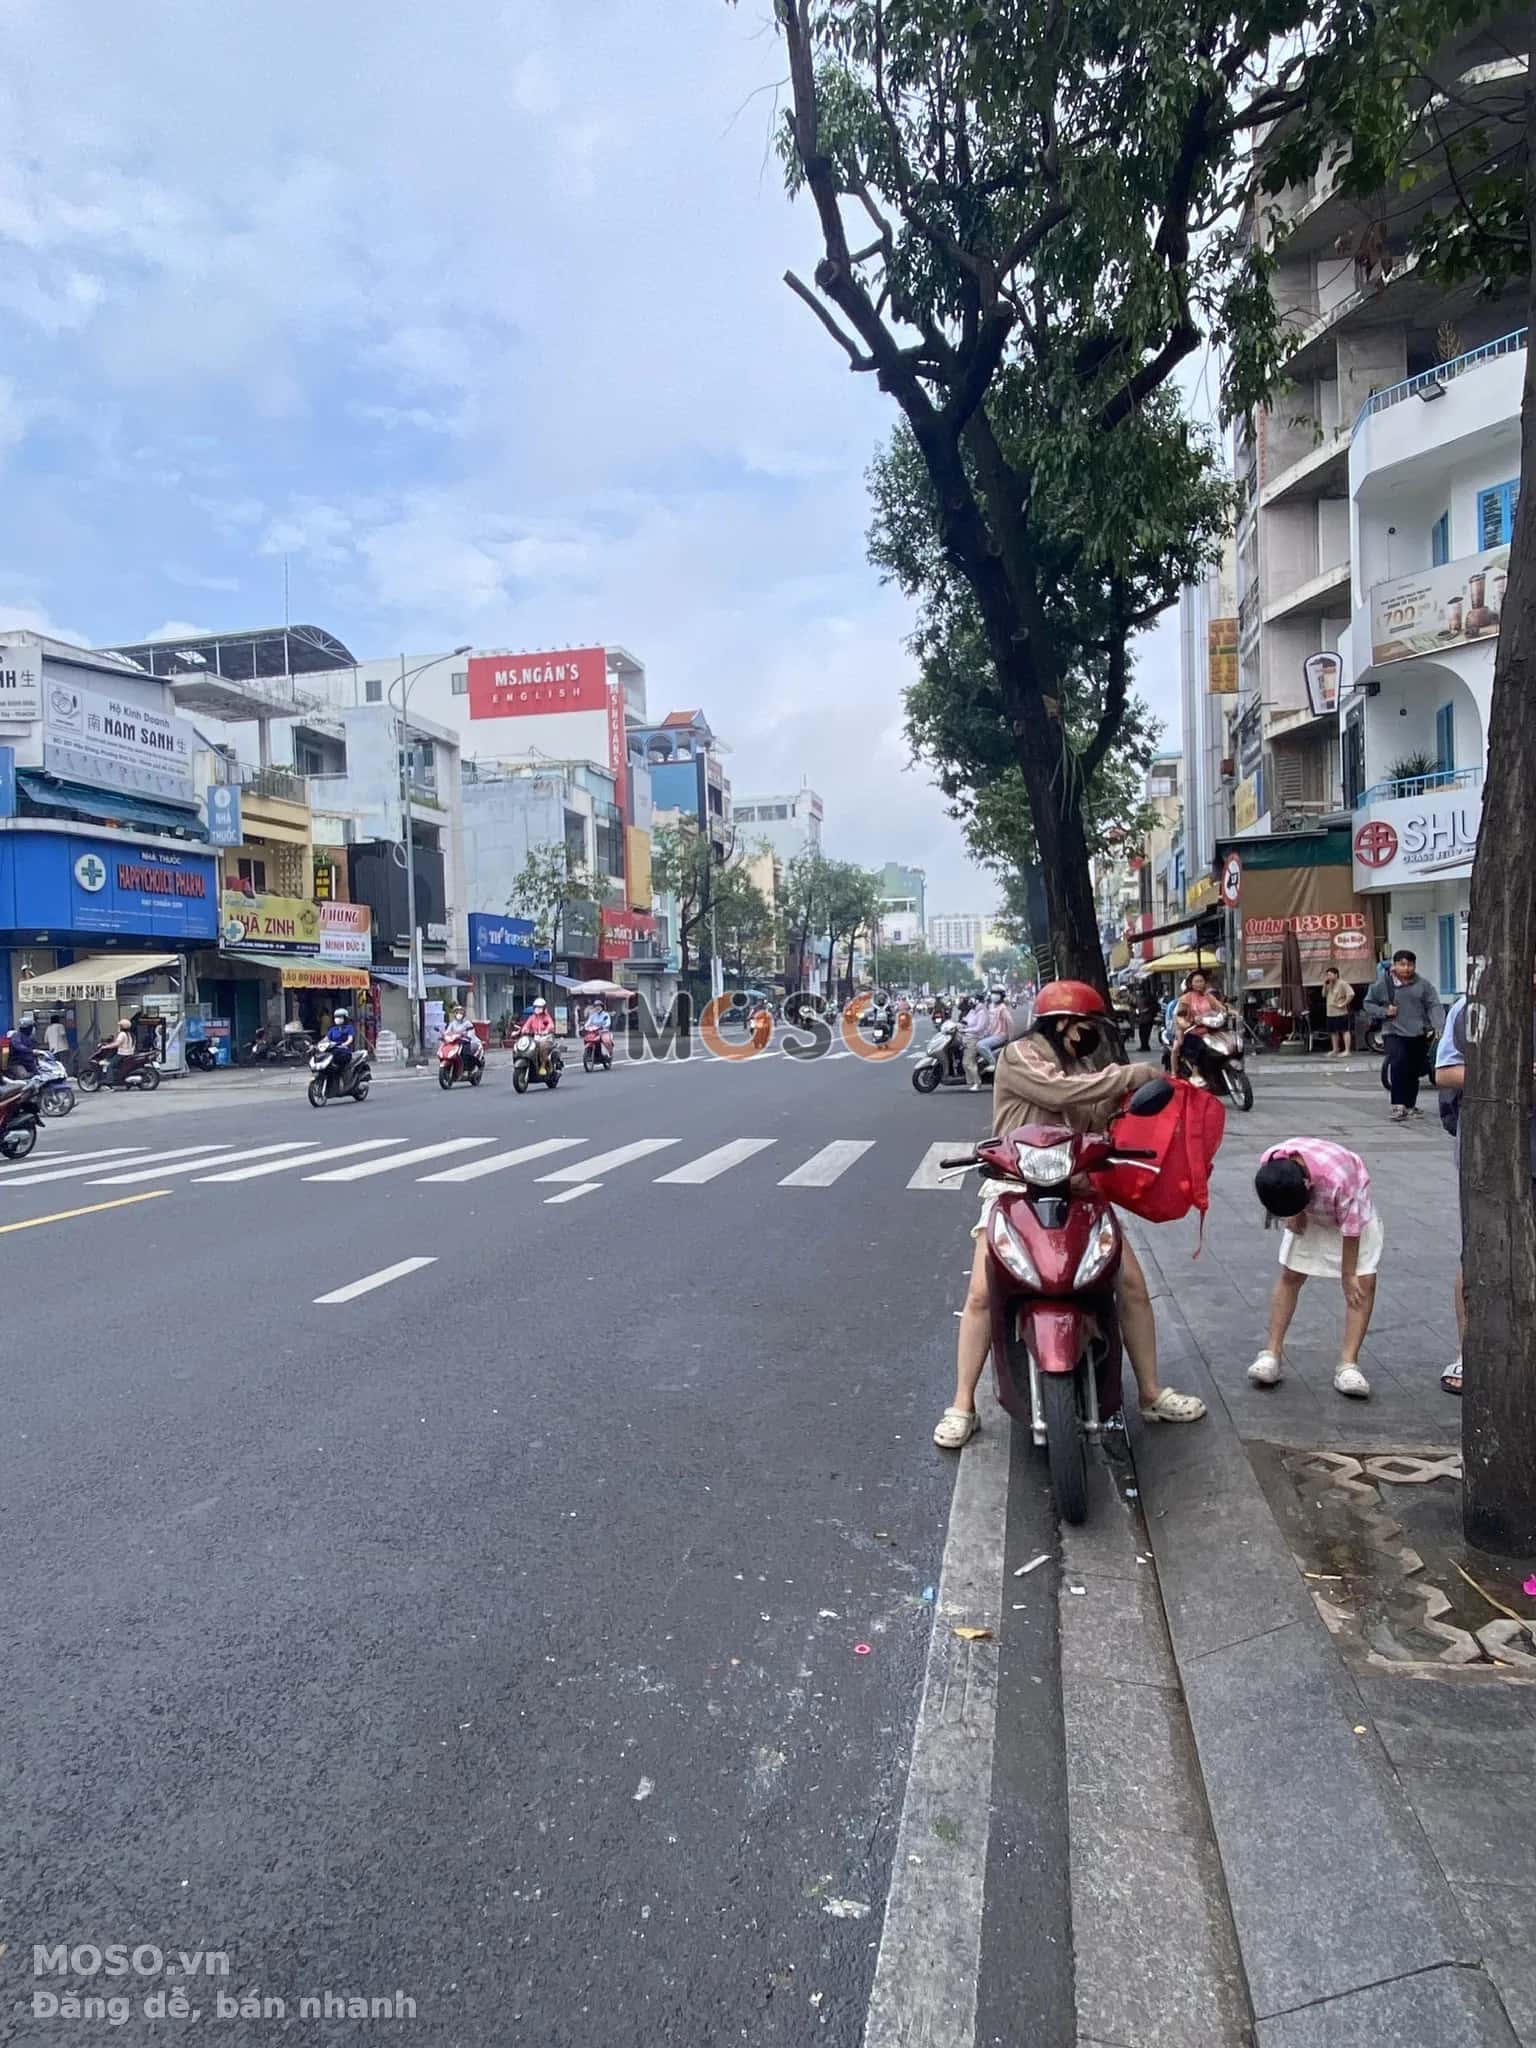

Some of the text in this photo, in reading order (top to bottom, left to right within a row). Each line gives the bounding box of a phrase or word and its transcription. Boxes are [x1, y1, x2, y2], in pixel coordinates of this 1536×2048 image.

[495, 662, 579, 687] MS.NGÂN'S
[492, 687, 581, 704] ENGLISH
[123, 706, 142, 720] Kinh
[143, 712, 170, 728] Doanh
[104, 717, 136, 741] NAM
[140, 728, 174, 751] SANH
[215, 808, 231, 824] NHÀ
[264, 917, 295, 937] ZINH
[1340, 912, 1366, 930] B
